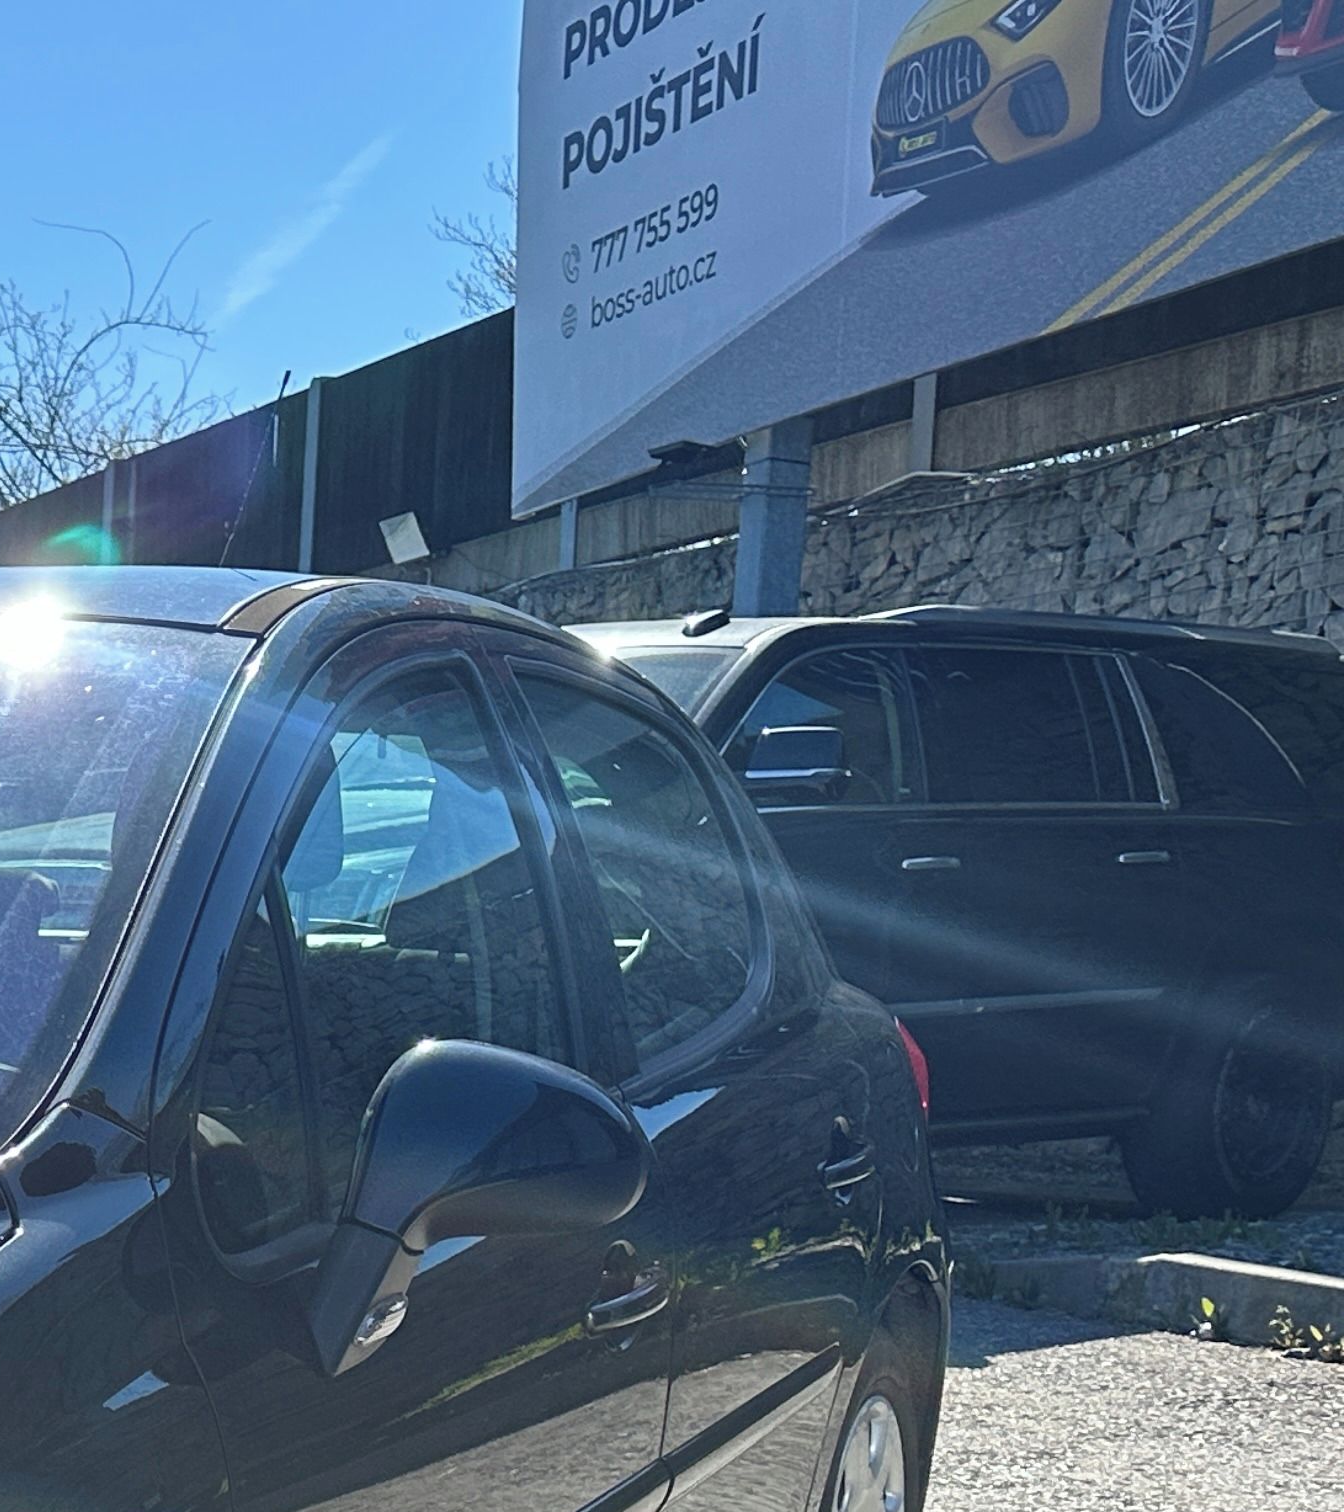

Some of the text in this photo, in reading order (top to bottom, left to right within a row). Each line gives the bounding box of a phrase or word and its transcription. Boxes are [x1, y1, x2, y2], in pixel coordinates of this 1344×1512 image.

[564, 0, 705, 80] PROD
[562, 12, 766, 190] POJIŠTĚNÍ
[591, 182, 719, 274] 777 755 599
[590, 250, 717, 329] boss-auto.cz
